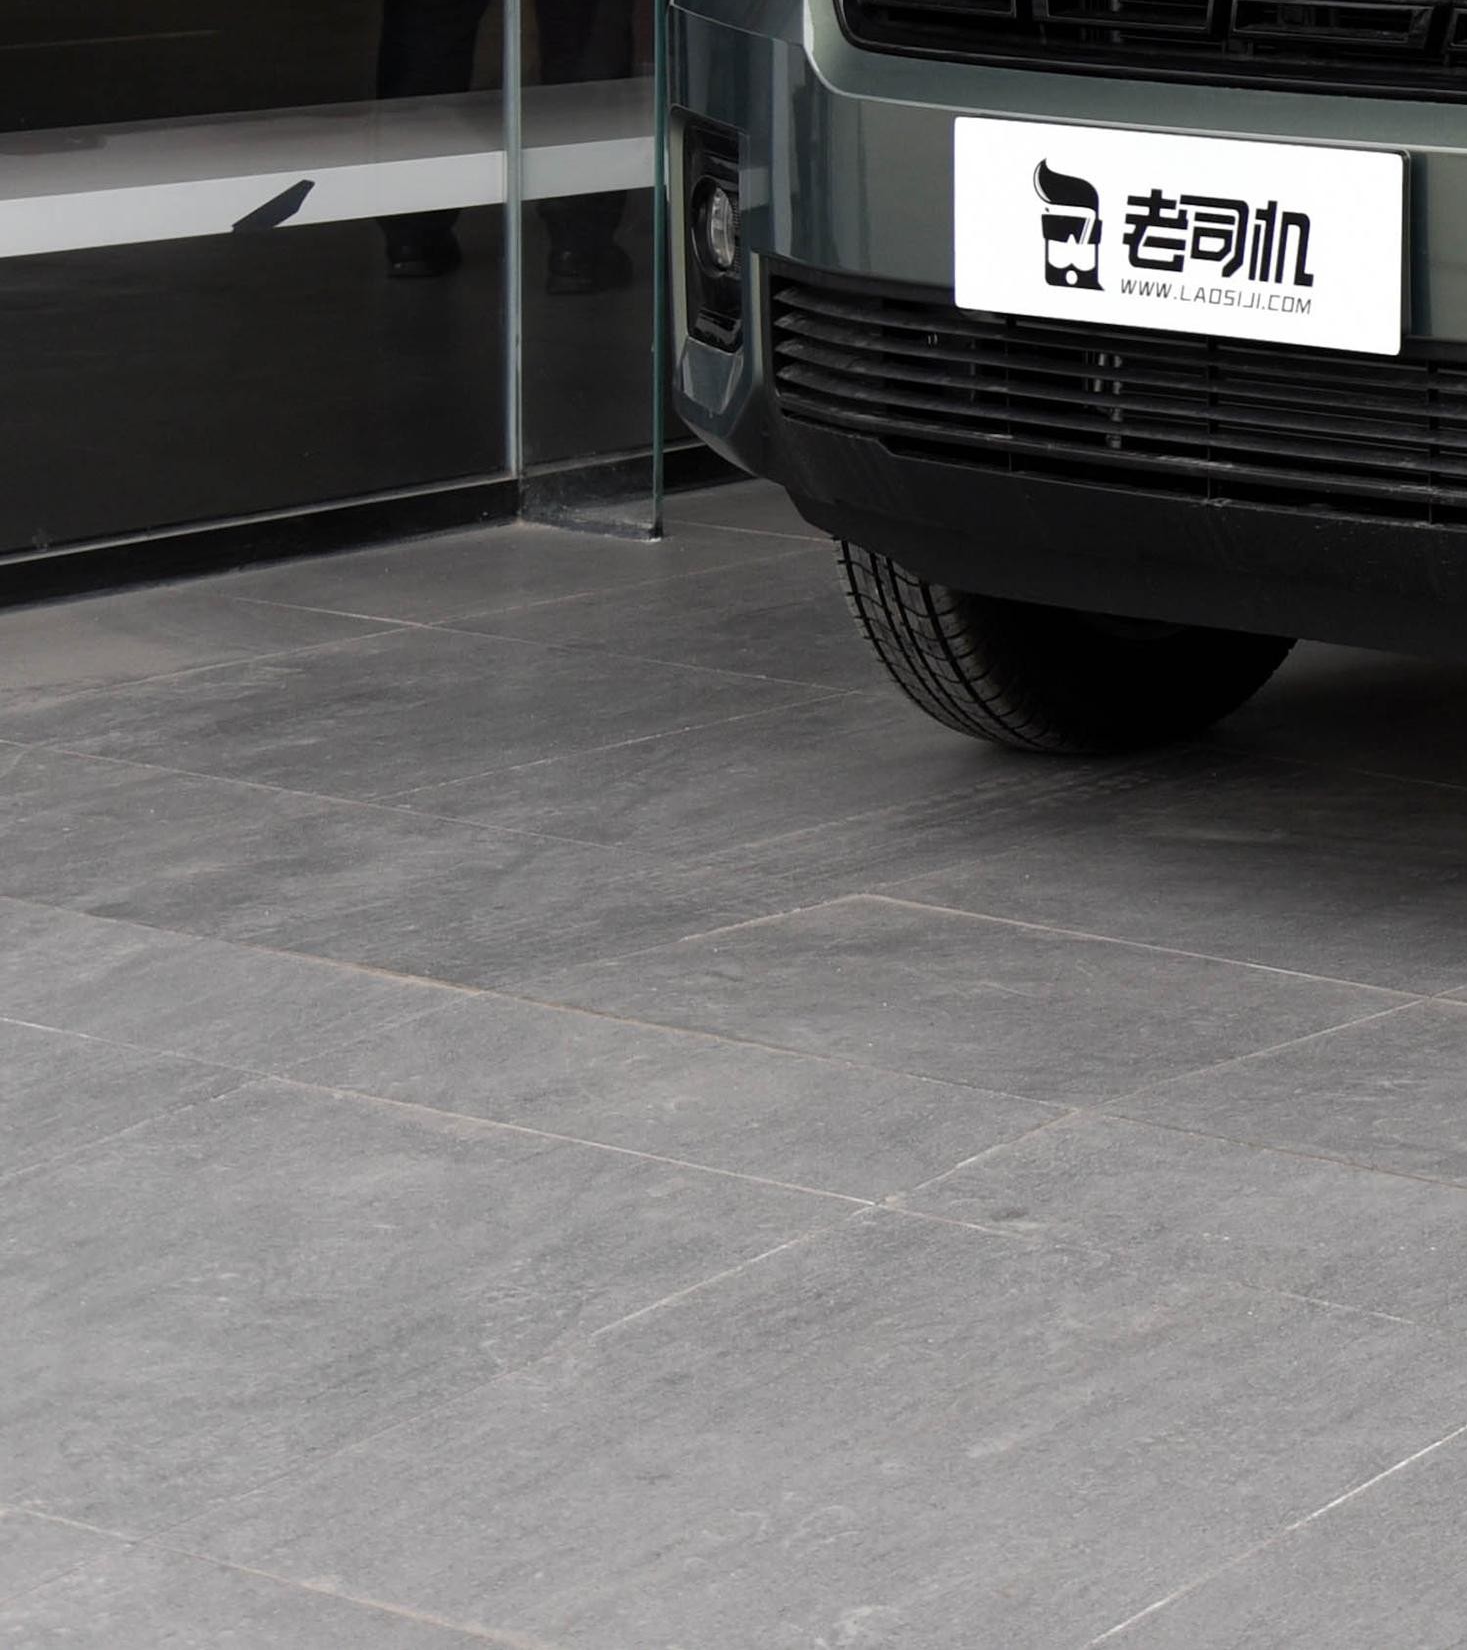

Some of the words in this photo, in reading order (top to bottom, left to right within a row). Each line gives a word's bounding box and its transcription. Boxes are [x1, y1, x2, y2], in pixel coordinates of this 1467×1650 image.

[1122, 188, 1314, 287] 老司机
[1120, 277, 1313, 316] WWW.LAOSIJI.COM
